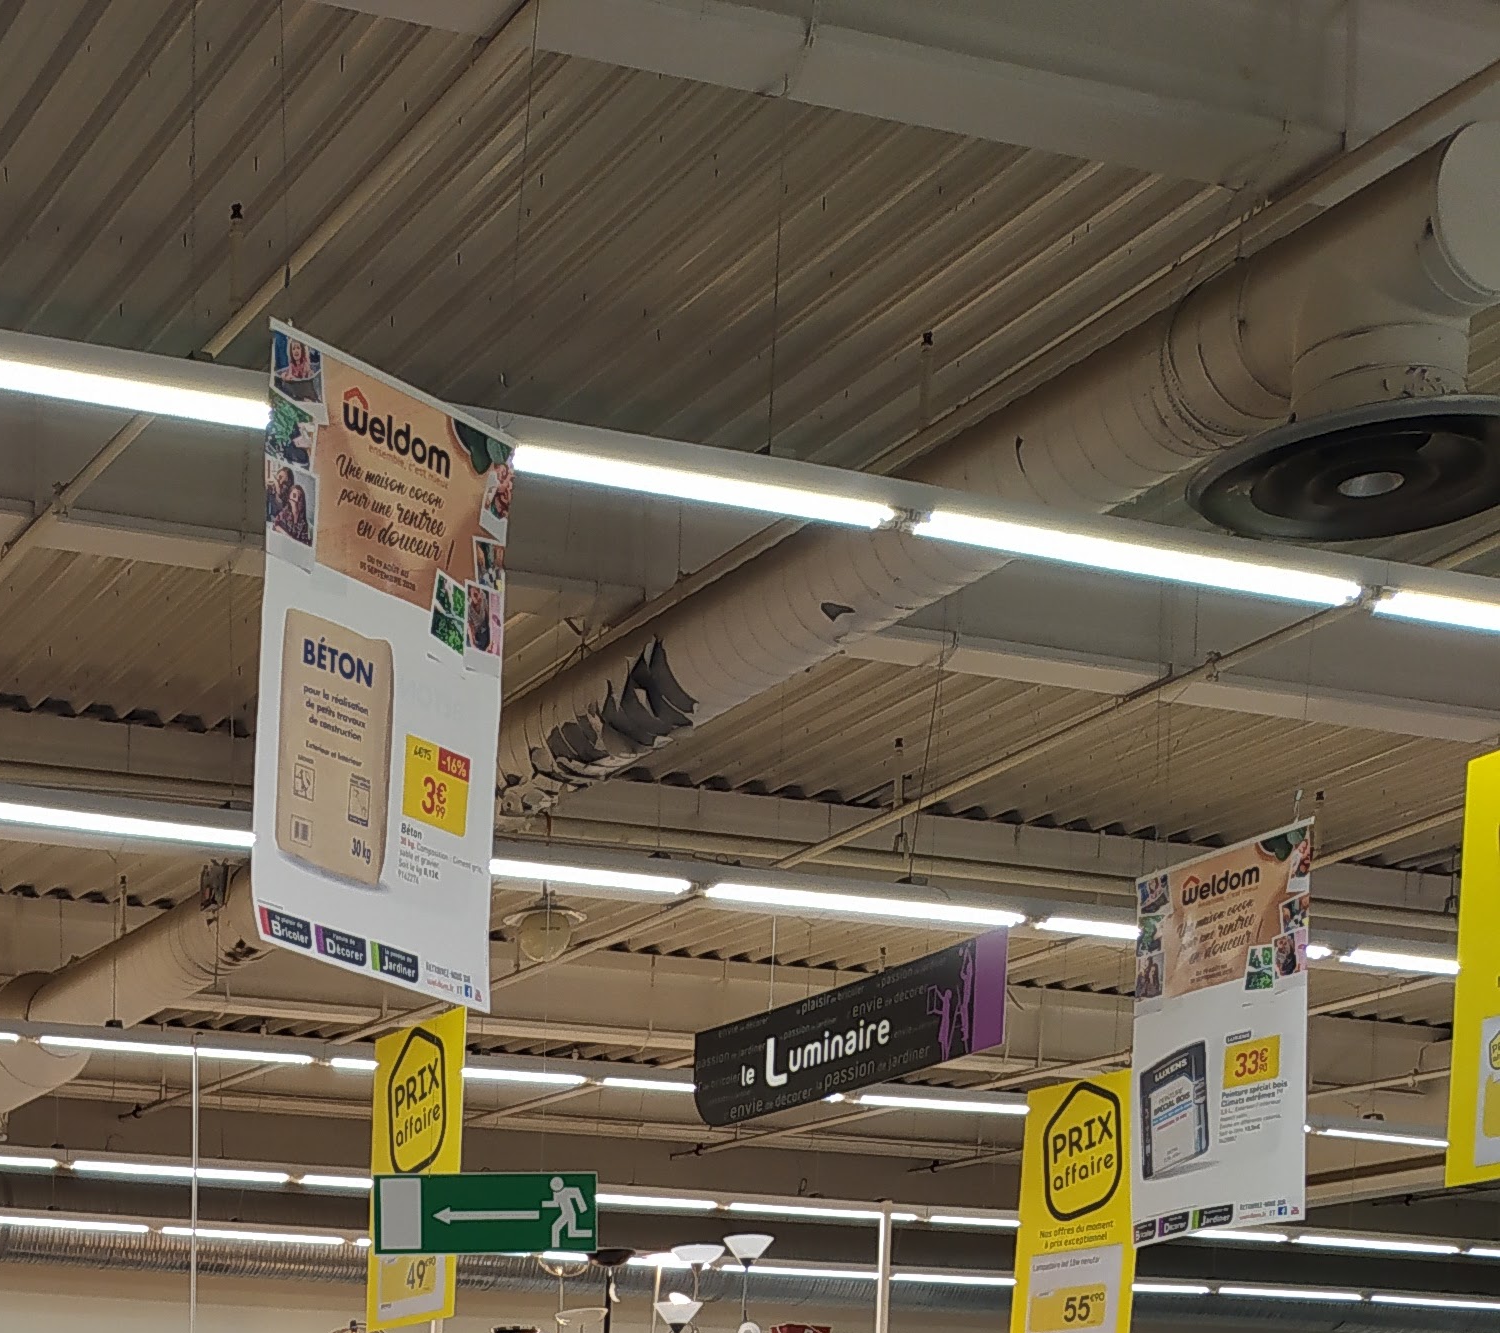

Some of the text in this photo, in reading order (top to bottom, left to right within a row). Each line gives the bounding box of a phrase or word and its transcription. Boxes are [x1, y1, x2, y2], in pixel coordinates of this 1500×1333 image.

[343, 399, 450, 479] weldom
[336, 454, 444, 509] Une maison cocon
[337, 488, 446, 537] pour une rentrée
[357, 520, 376, 539] en
[378, 522, 442, 561] douceur
[303, 636, 373, 688] BÉTON
[441, 755, 466, 777] -16%
[352, 837, 371, 865] 30 kg
[400, 822, 422, 840] Béton
[1182, 866, 1259, 906] weldom
[271, 920, 309, 945] Bricoler
[383, 955, 416, 979] Jardiner
[741, 1019, 891, 1087] le Luminaire
[1154, 1058, 1188, 1083] LUXENS
[394, 1058, 440, 1119] PRIX
[396, 1103, 441, 1147] affaire
[1052, 1111, 1113, 1164] PRIX
[1053, 1152, 1114, 1191] affaire
